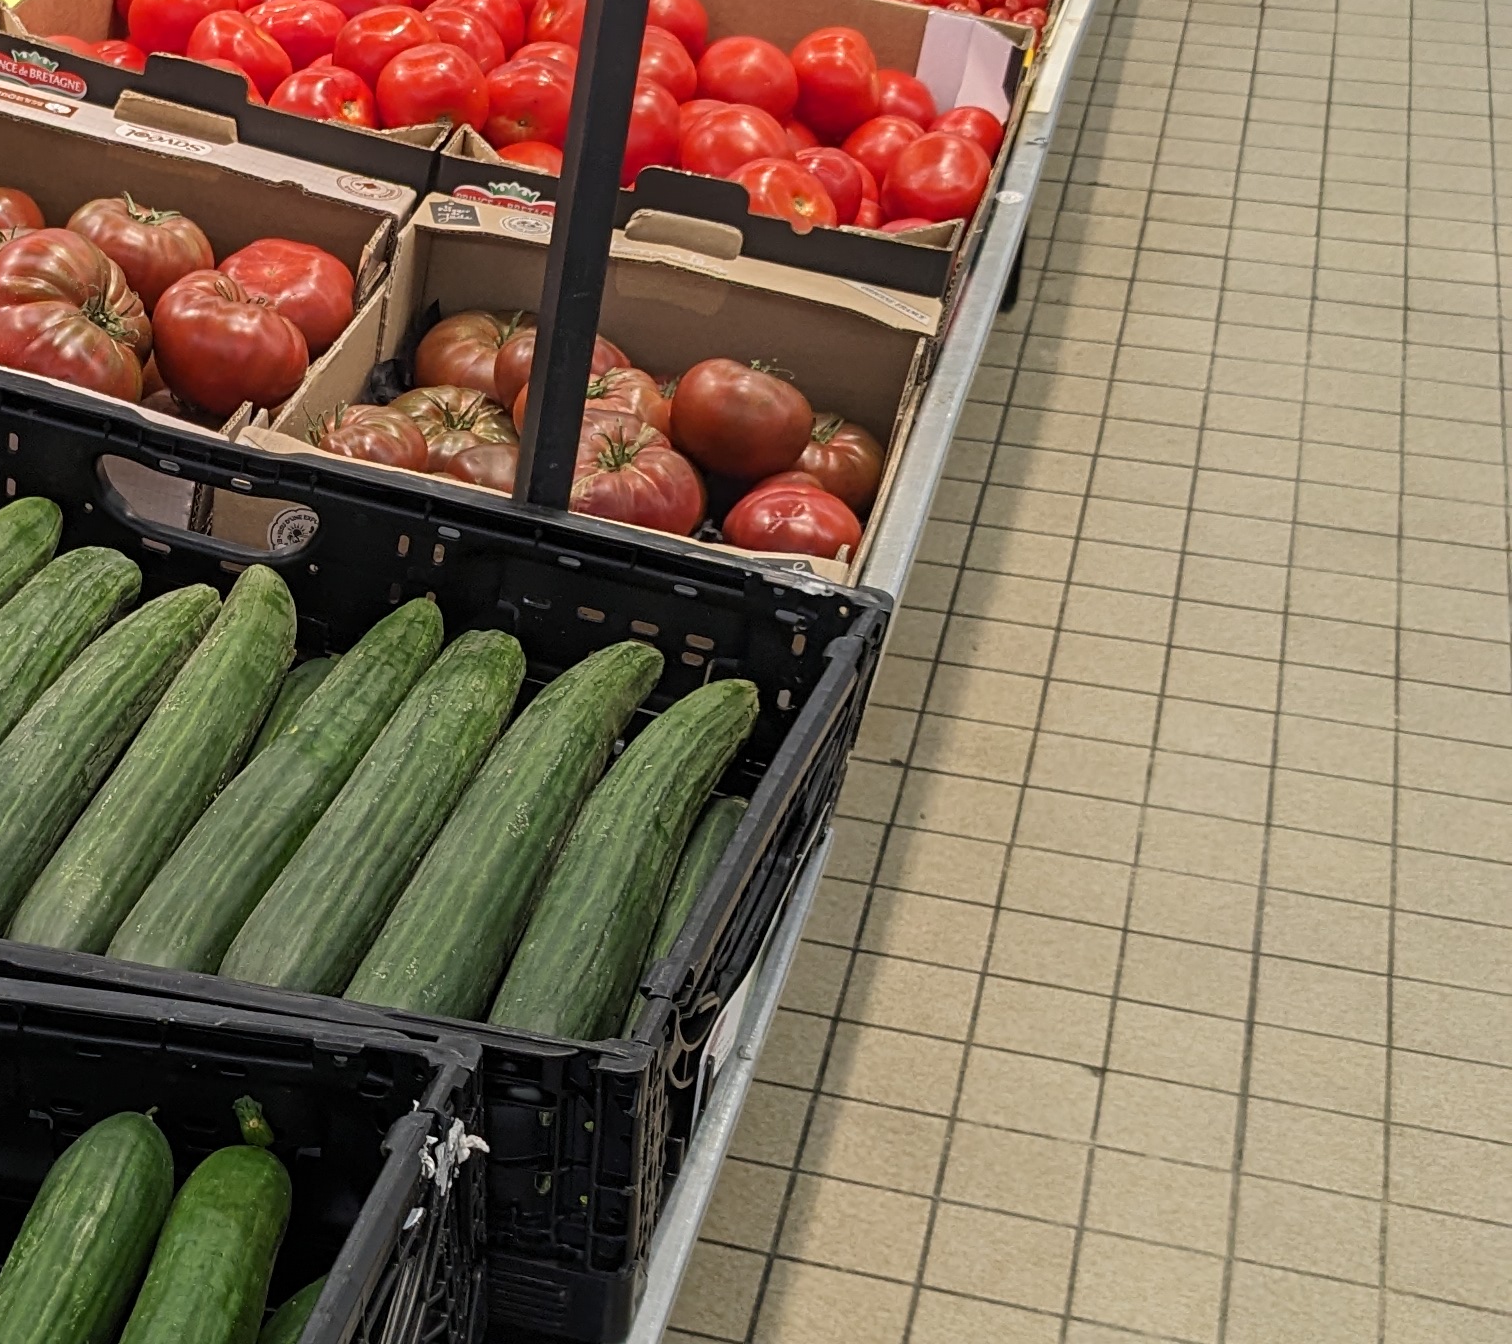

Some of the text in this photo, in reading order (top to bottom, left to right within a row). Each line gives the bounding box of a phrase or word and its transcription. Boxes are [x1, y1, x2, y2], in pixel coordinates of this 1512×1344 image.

[18, 67, 28, 77] de
[28, 66, 82, 92] BRETAGNE
[127, 128, 206, 154] Savéol
